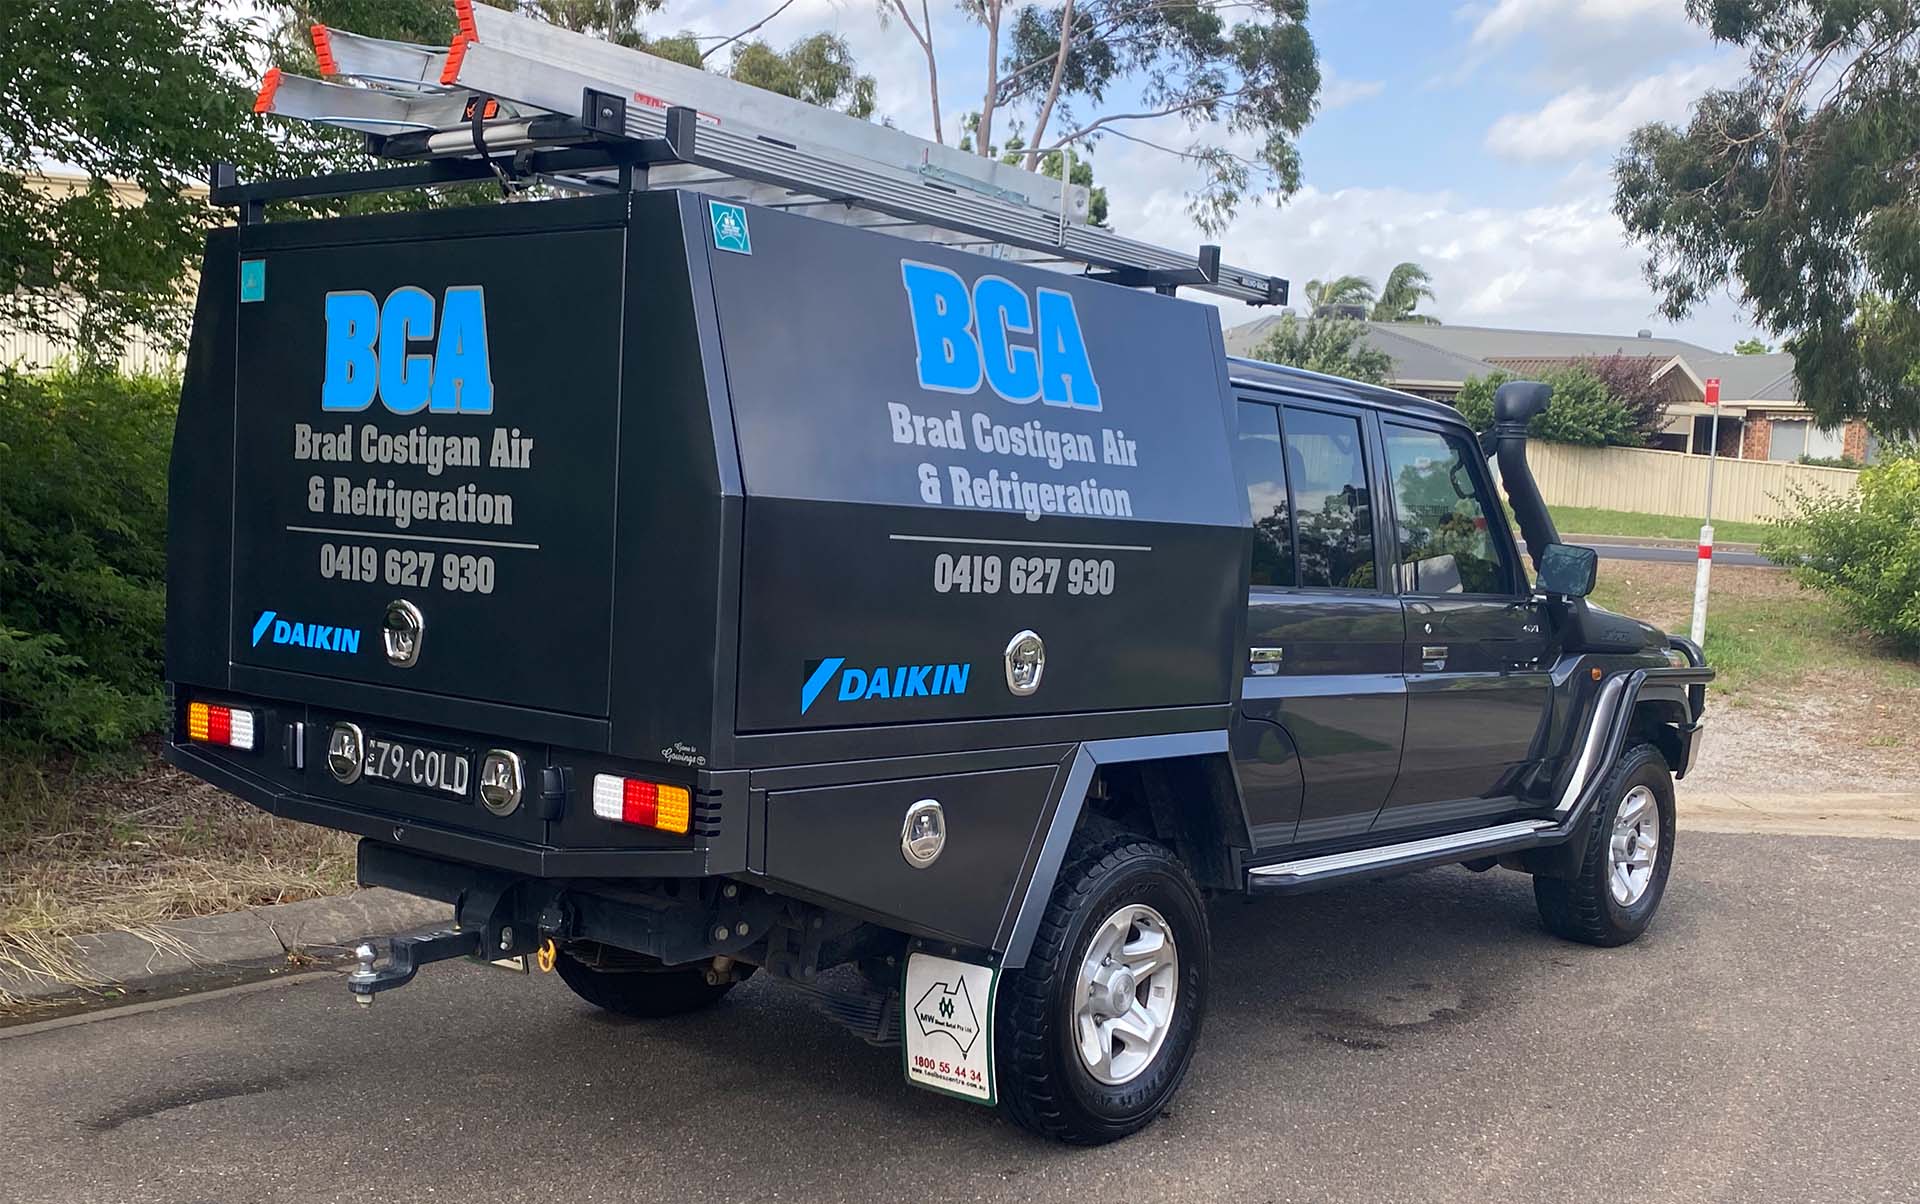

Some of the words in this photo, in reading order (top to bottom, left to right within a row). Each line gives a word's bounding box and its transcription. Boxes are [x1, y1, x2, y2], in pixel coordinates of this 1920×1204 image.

[321, 285, 495, 415] BCA
[900, 258, 1103, 412] BCA
[294, 423, 353, 462] Brad
[360, 427, 481, 476] Costigan
[489, 428, 534, 469] Air
[887, 402, 966, 451] Brad
[972, 410, 1096, 470] Costigan
[1102, 428, 1138, 468] Air
[308, 475, 325, 513] &
[333, 478, 514, 528] Refrigeration
[918, 463, 941, 504] &
[948, 466, 1133, 522] Refrigeration
[320, 544, 378, 584] 0419
[384, 549, 435, 587] 627
[442, 555, 496, 594] 930
[934, 553, 1002, 594] 0419
[1010, 557, 1061, 595] 627
[1067, 559, 1116, 596] 930
[272, 619, 361, 654] DAIKIN
[838, 663, 970, 702] DAIKIN
[662, 748, 696, 766] Gowings
[920, 1013, 934, 1023] MW
[914, 1056, 935, 1070] 1800
[939, 1062, 950, 1073] 55
[955, 1066, 966, 1078] 44
[970, 1069, 982, 1082] 34
